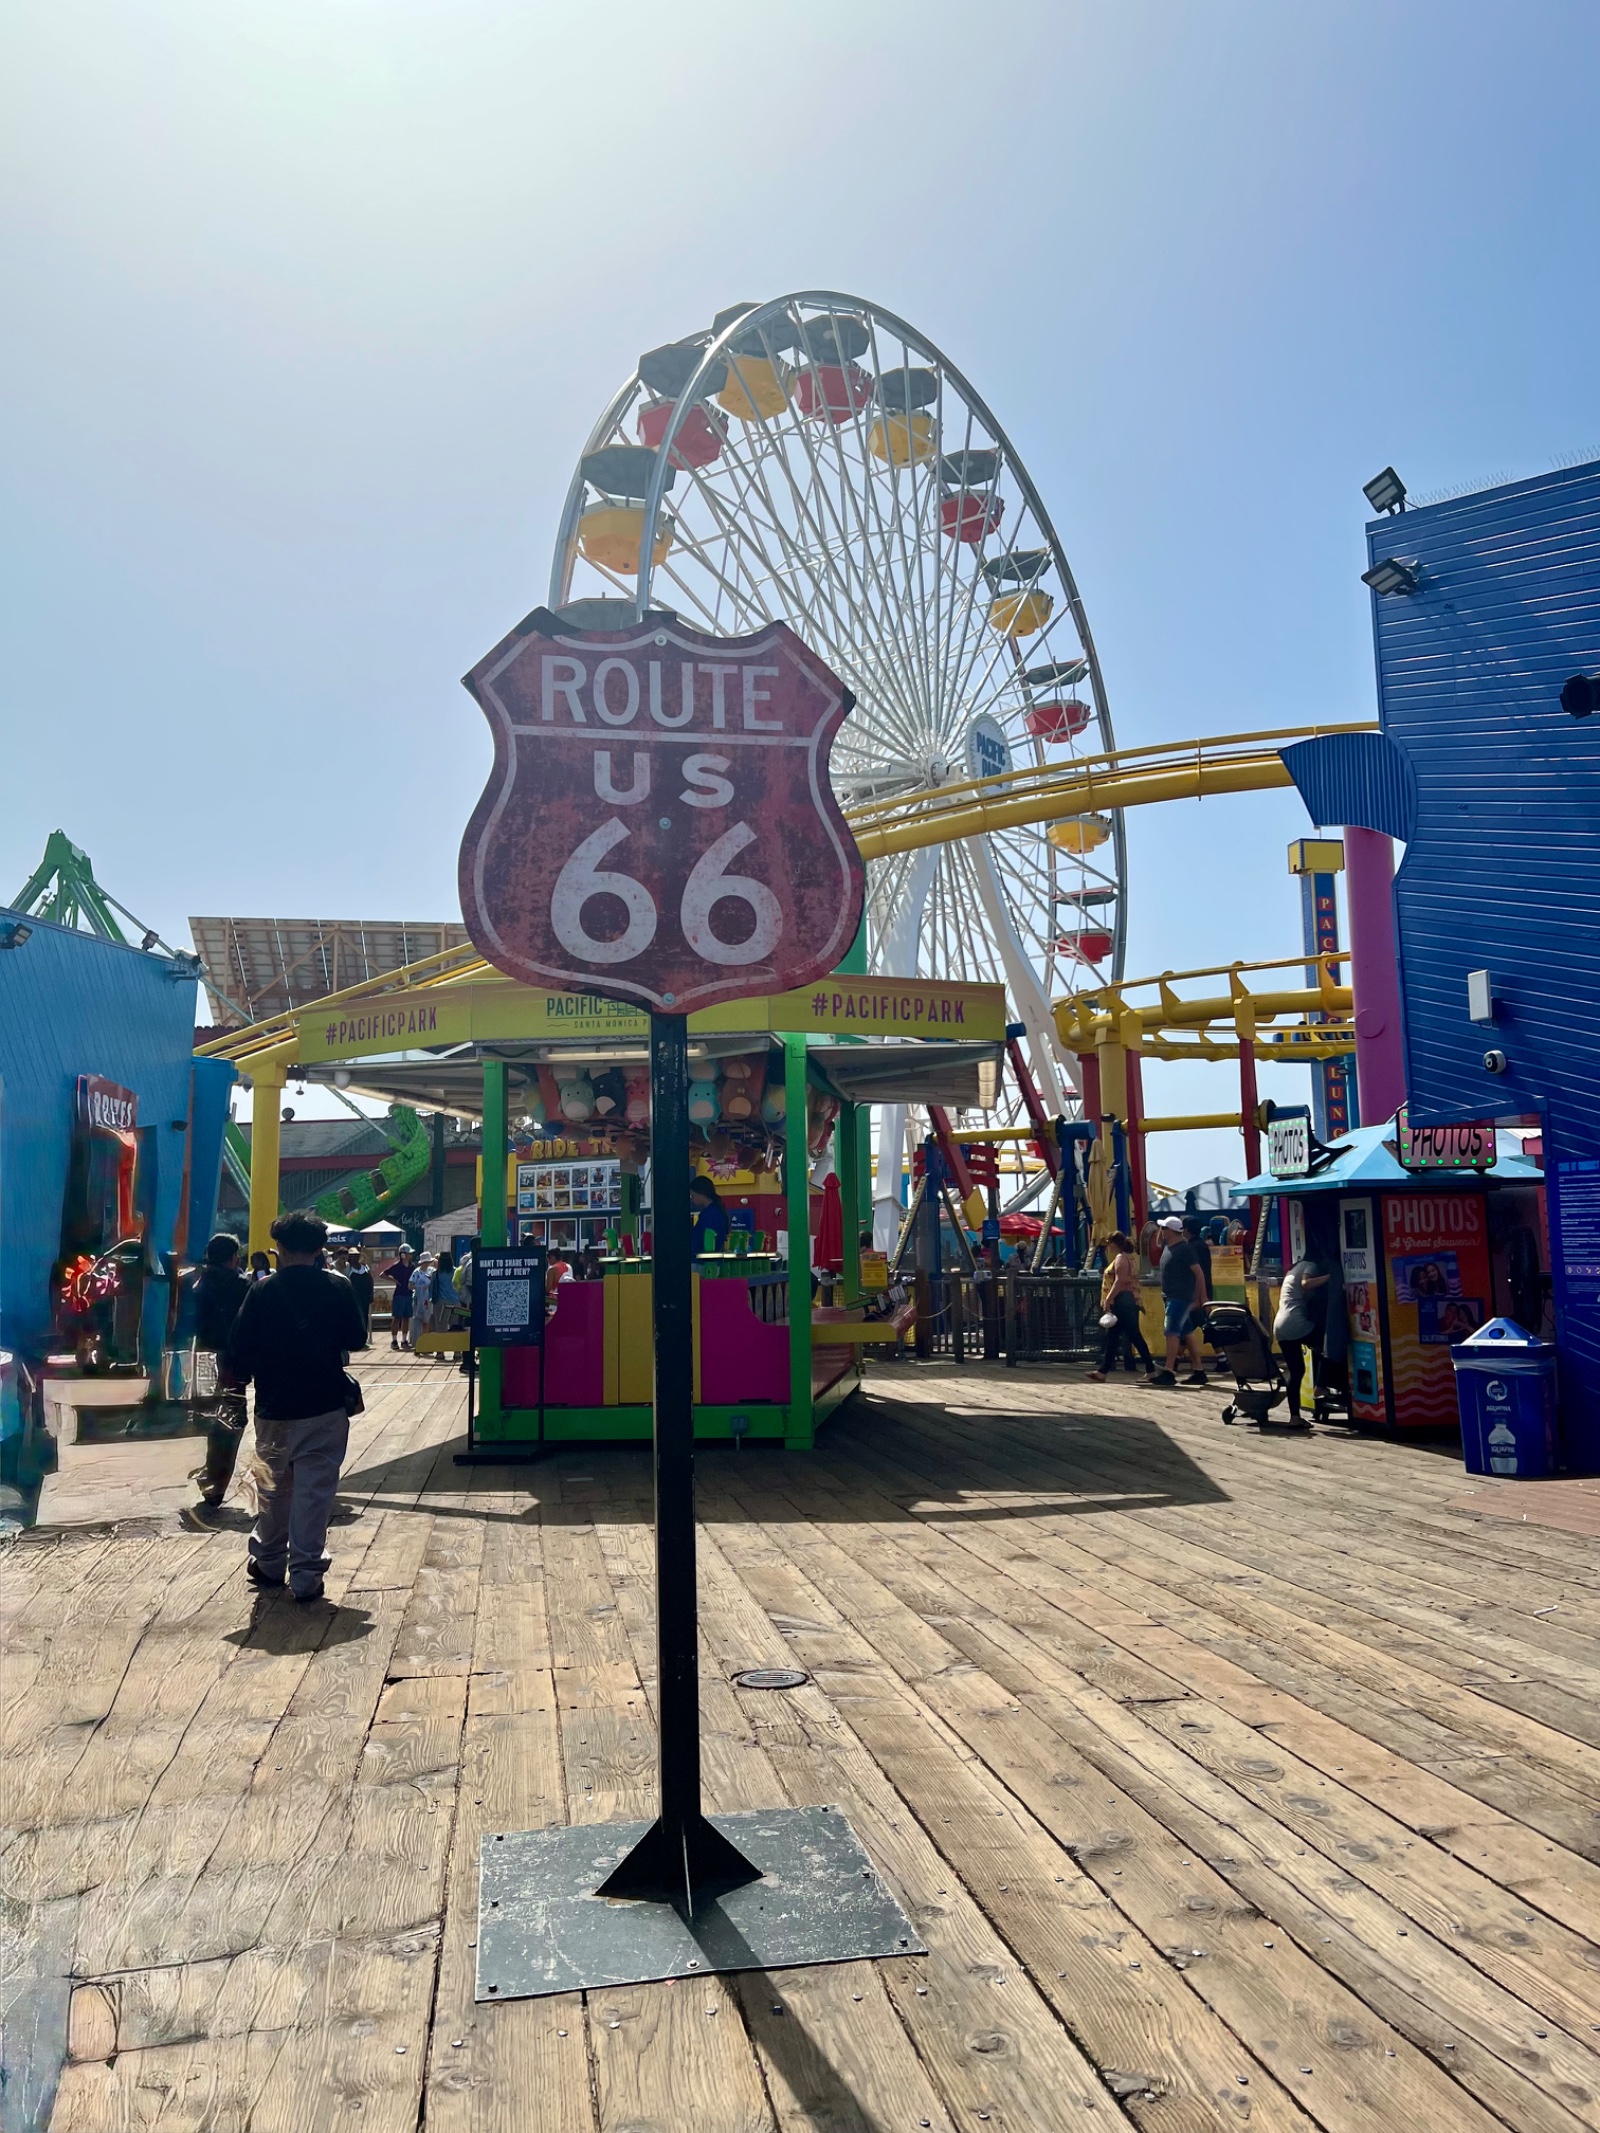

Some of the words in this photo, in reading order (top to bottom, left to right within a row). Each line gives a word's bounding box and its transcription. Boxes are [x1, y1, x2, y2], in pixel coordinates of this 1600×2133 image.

[541, 655, 783, 731] ROUTE
[550, 816, 784, 966] 66
[546, 996, 603, 1017] PACIFIC
[812, 992, 965, 1024] #PACIFICPARK
[325, 1006, 437, 1046] #PACIFICPARK
[574, 1020, 601, 1029] SANTA
[605, 1019, 638, 1028] MONICA
[531, 1139, 580, 1160] RIDE
[1274, 1126, 1304, 1165] PHOTOS
[1411, 1128, 1483, 1157] PHOTOS
[1387, 1198, 1479, 1234] PHOTOS
[327, 1234, 347, 1243] zels
[1389, 1238, 1401, 1248] A
[1402, 1236, 1431, 1251] Great
[1433, 1236, 1482, 1250] Souvenir!
